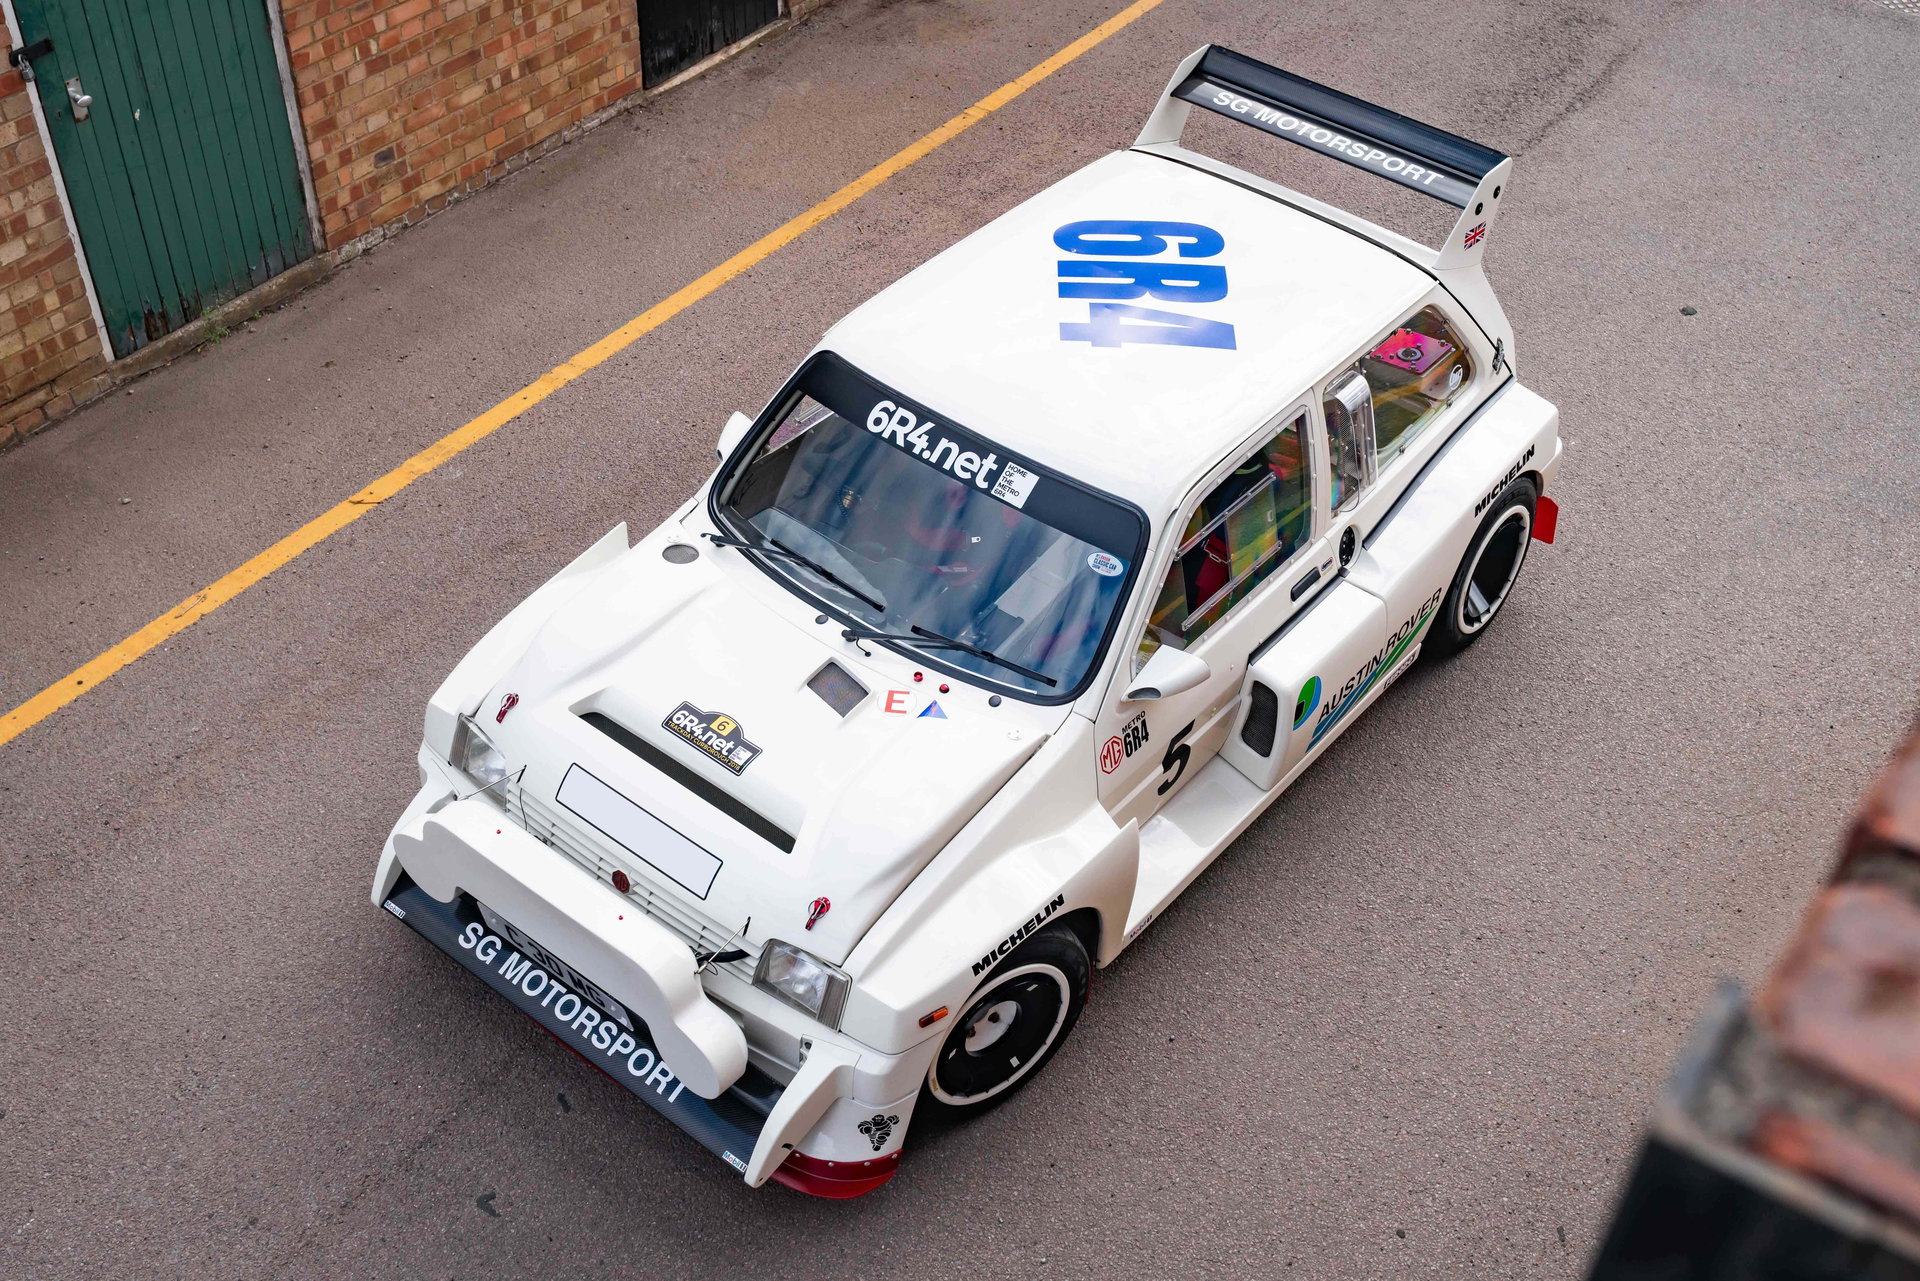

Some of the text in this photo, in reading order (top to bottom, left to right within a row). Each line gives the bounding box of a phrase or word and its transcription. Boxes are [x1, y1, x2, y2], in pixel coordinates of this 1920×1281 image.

[1212, 91, 1445, 186] SG MOTORSPORT
[1053, 220, 1237, 350] 6R4
[866, 400, 999, 489] 6R4.net
[993, 488, 1006, 498] 6R4
[997, 482, 1020, 497] METRO
[1001, 476, 1014, 487] THE
[1004, 470, 1014, 478] OF
[1007, 464, 1028, 478] HOME
[1474, 443, 1535, 519] MICHELIN
[1317, 648, 1385, 724] AUSTIN
[1385, 587, 1441, 655] ROVER
[884, 690, 910, 714] E
[1121, 710, 1146, 734] METRO
[667, 721, 695, 741] TRACKDAY
[693, 737, 729, 763] CURBOROUGH
[672, 710, 735, 756] 6R4.net
[716, 721, 730, 731] 6
[1103, 718, 1149, 768] MG 6R4
[1157, 718, 1195, 796] 5
[458, 921, 501, 966] SG
[971, 893, 1065, 977] MICHELIN
